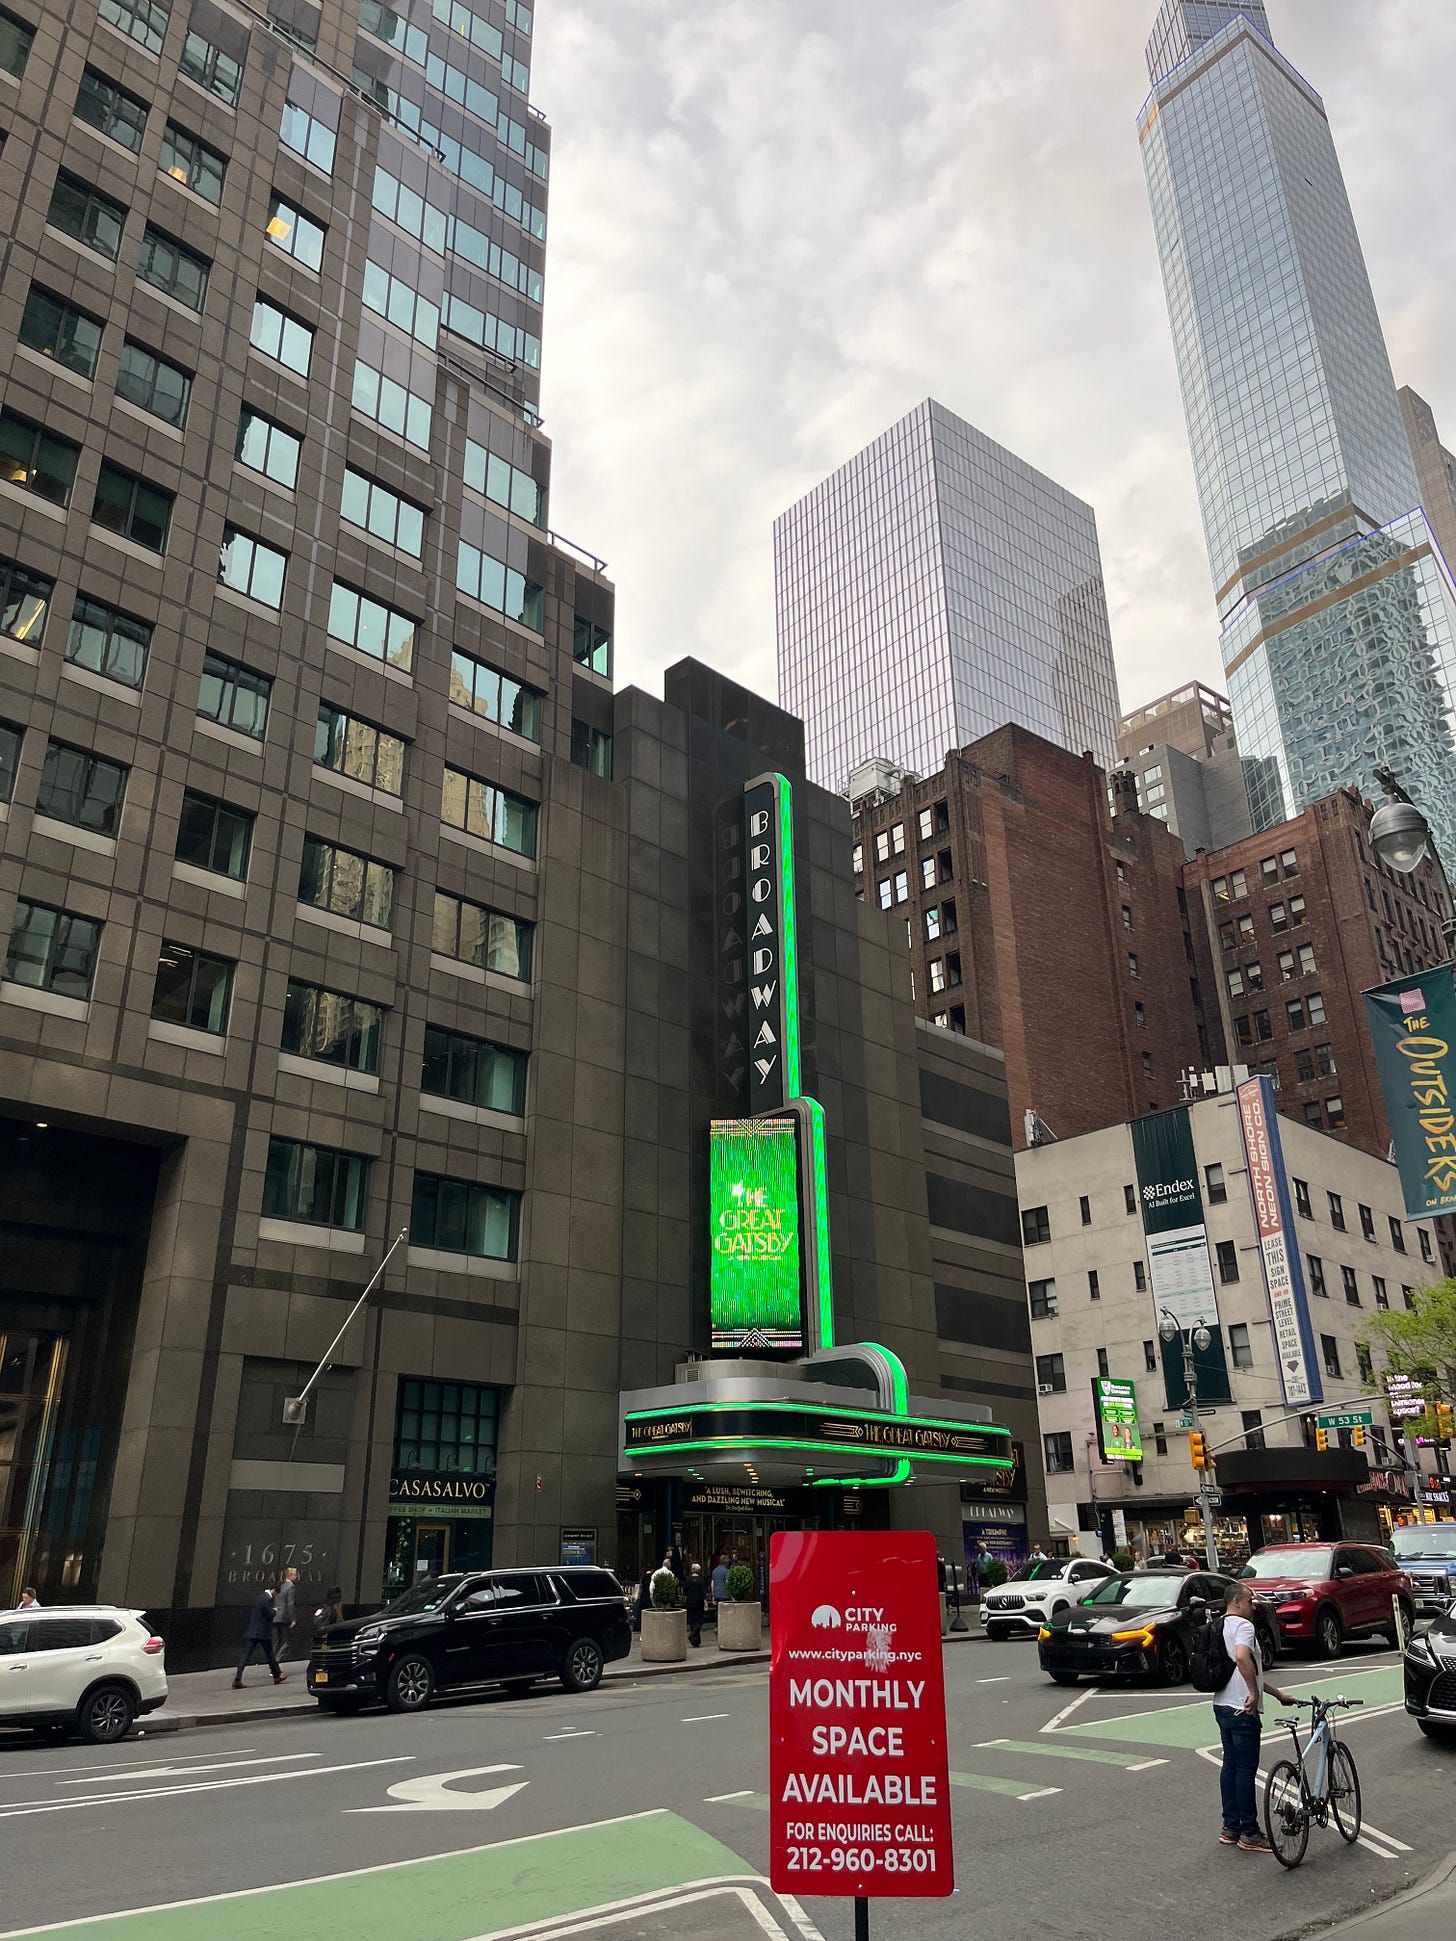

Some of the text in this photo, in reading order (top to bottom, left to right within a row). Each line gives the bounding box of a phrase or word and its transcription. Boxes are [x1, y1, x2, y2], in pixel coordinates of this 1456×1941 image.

[750, 810, 777, 1085] BROADWAY
[1403, 1015, 1431, 1032] THE
[1396, 1036, 1456, 1193] OUTSIDERS
[1243, 1104, 1258, 1163] SHORE
[1252, 1099, 1279, 1228] NEON SIGN CO.
[734, 1185, 768, 1208] THE
[1155, 1178, 1195, 1198] Endex
[1148, 1192, 1195, 1208] AI Built for Excel
[1253, 1166, 1270, 1230] NORTH
[1425, 1198, 1437, 1207] ON
[719, 1208, 785, 1231] GREAT
[715, 1232, 794, 1254] GATSBY
[1264, 1236, 1282, 1251] LEASE
[1266, 1248, 1285, 1266] THIS
[1270, 1265, 1285, 1278] SIGN
[1269, 1275, 1289, 1290] SPACE
[1274, 1298, 1291, 1310] PRIME
[1275, 1307, 1293, 1320] STREET
[1278, 1317, 1293, 1328] LEVEL
[1281, 1338, 1298, 1350] SPACE
[643, 1424, 664, 1437] GREAT
[665, 1421, 692, 1435] GATSBY
[1328, 1414, 1363, 1426] W 53 St
[864, 1423, 951, 1449] THE GREAT GATSBY
[389, 1478, 486, 1499] CASASALVO
[691, 1495, 706, 1503] AND
[707, 1495, 740, 1505] DAZZLING
[740, 1497, 755, 1505] NEW
[408, 1505, 426, 1513] SHOP
[460, 1507, 487, 1515] MARKET
[243, 1543, 314, 1565] 1675
[844, 1607, 884, 1622] CITY
[845, 1623, 897, 1633] PARKING
[788, 1648, 922, 1662] www.cityparking.nyc
[789, 1678, 925, 1709] MONTHLY
[812, 1725, 905, 1756] SPACE
[781, 1773, 937, 1805] AVAILABLE
[786, 1822, 934, 1845] FOR ENQUIRIES CALL:
[786, 1846, 936, 1872] 212-960-8301
